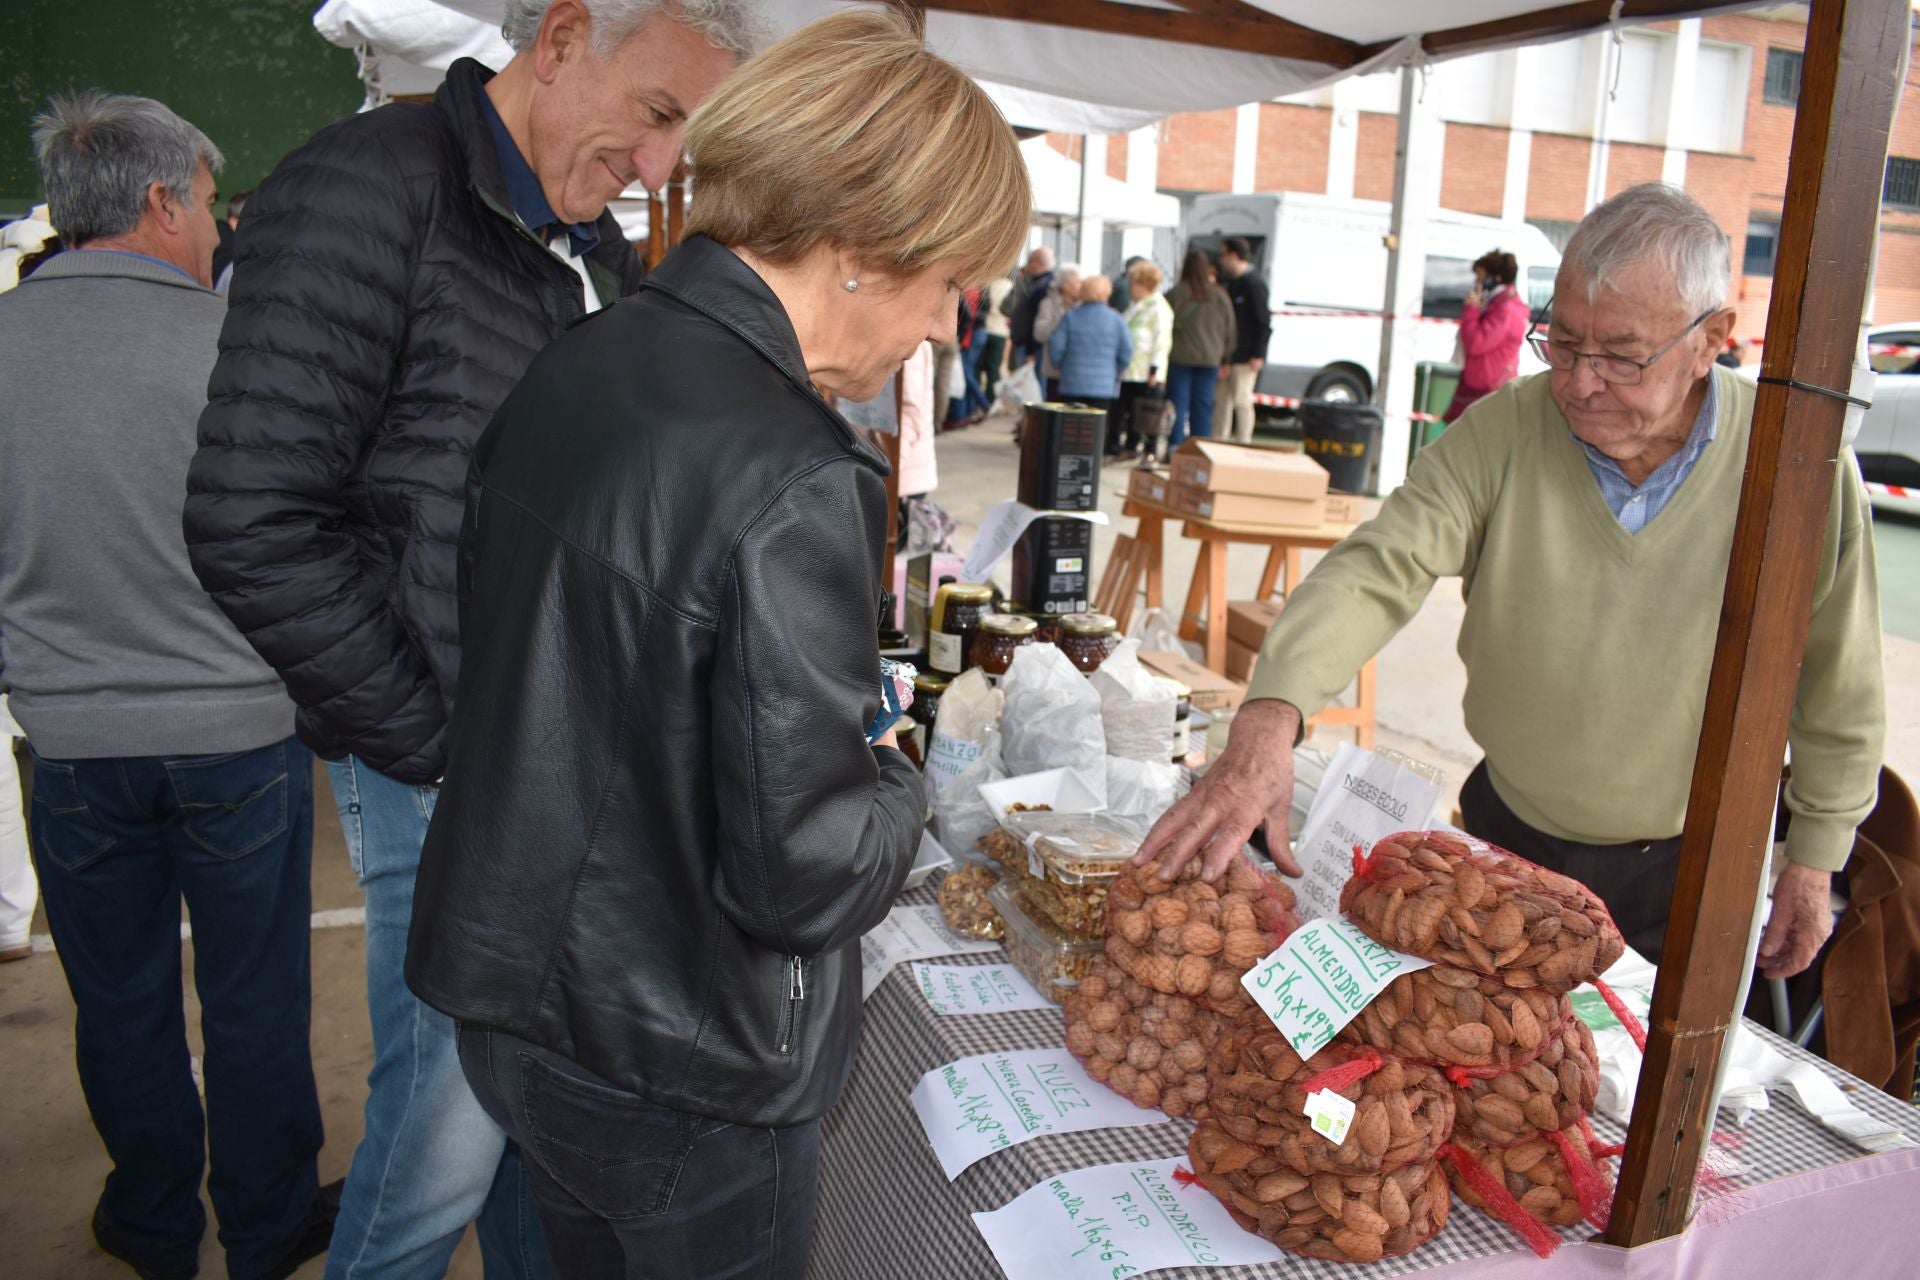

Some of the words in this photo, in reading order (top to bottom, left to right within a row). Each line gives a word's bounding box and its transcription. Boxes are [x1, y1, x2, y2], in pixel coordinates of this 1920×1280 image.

[1344, 773, 1379, 802] NUECES
[1331, 821, 1346, 839] SIN
[1322, 840, 1335, 858] SIN
[990, 970, 1019, 1003] NUEZ
[1257, 961, 1285, 988] 5
[1037, 1063, 1091, 1112] NUEZ
[1049, 1179, 1085, 1219] malla
